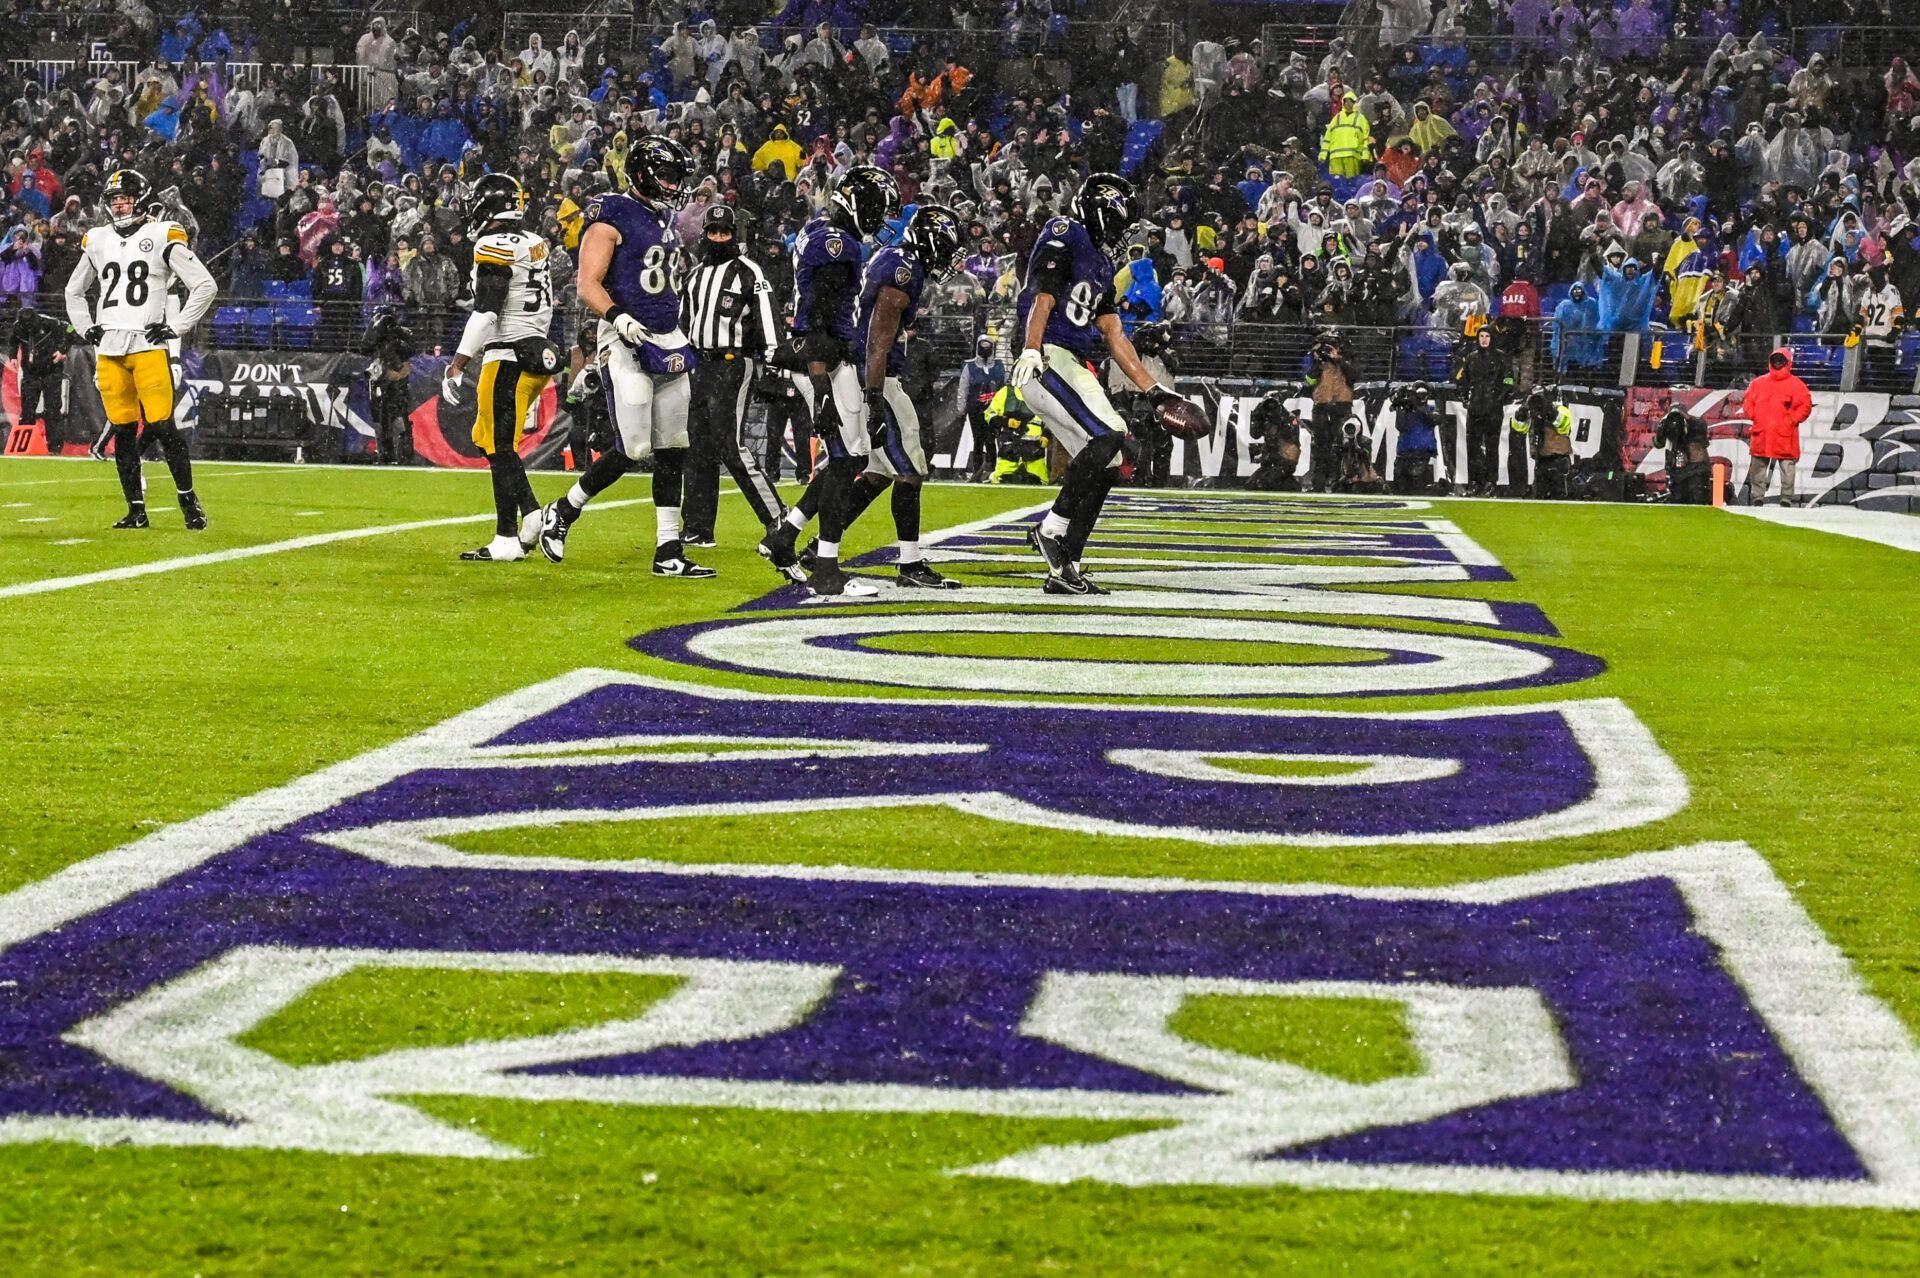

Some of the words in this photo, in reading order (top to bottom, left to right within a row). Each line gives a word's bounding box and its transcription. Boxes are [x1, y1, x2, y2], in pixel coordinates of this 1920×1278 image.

[797, 110, 811, 126] 52
[102, 260, 149, 309] 28
[754, 281, 768, 292] 38
[1867, 303, 1886, 327] 92
[230, 363, 303, 383] DON'T
[10, 429, 33, 452] 10
